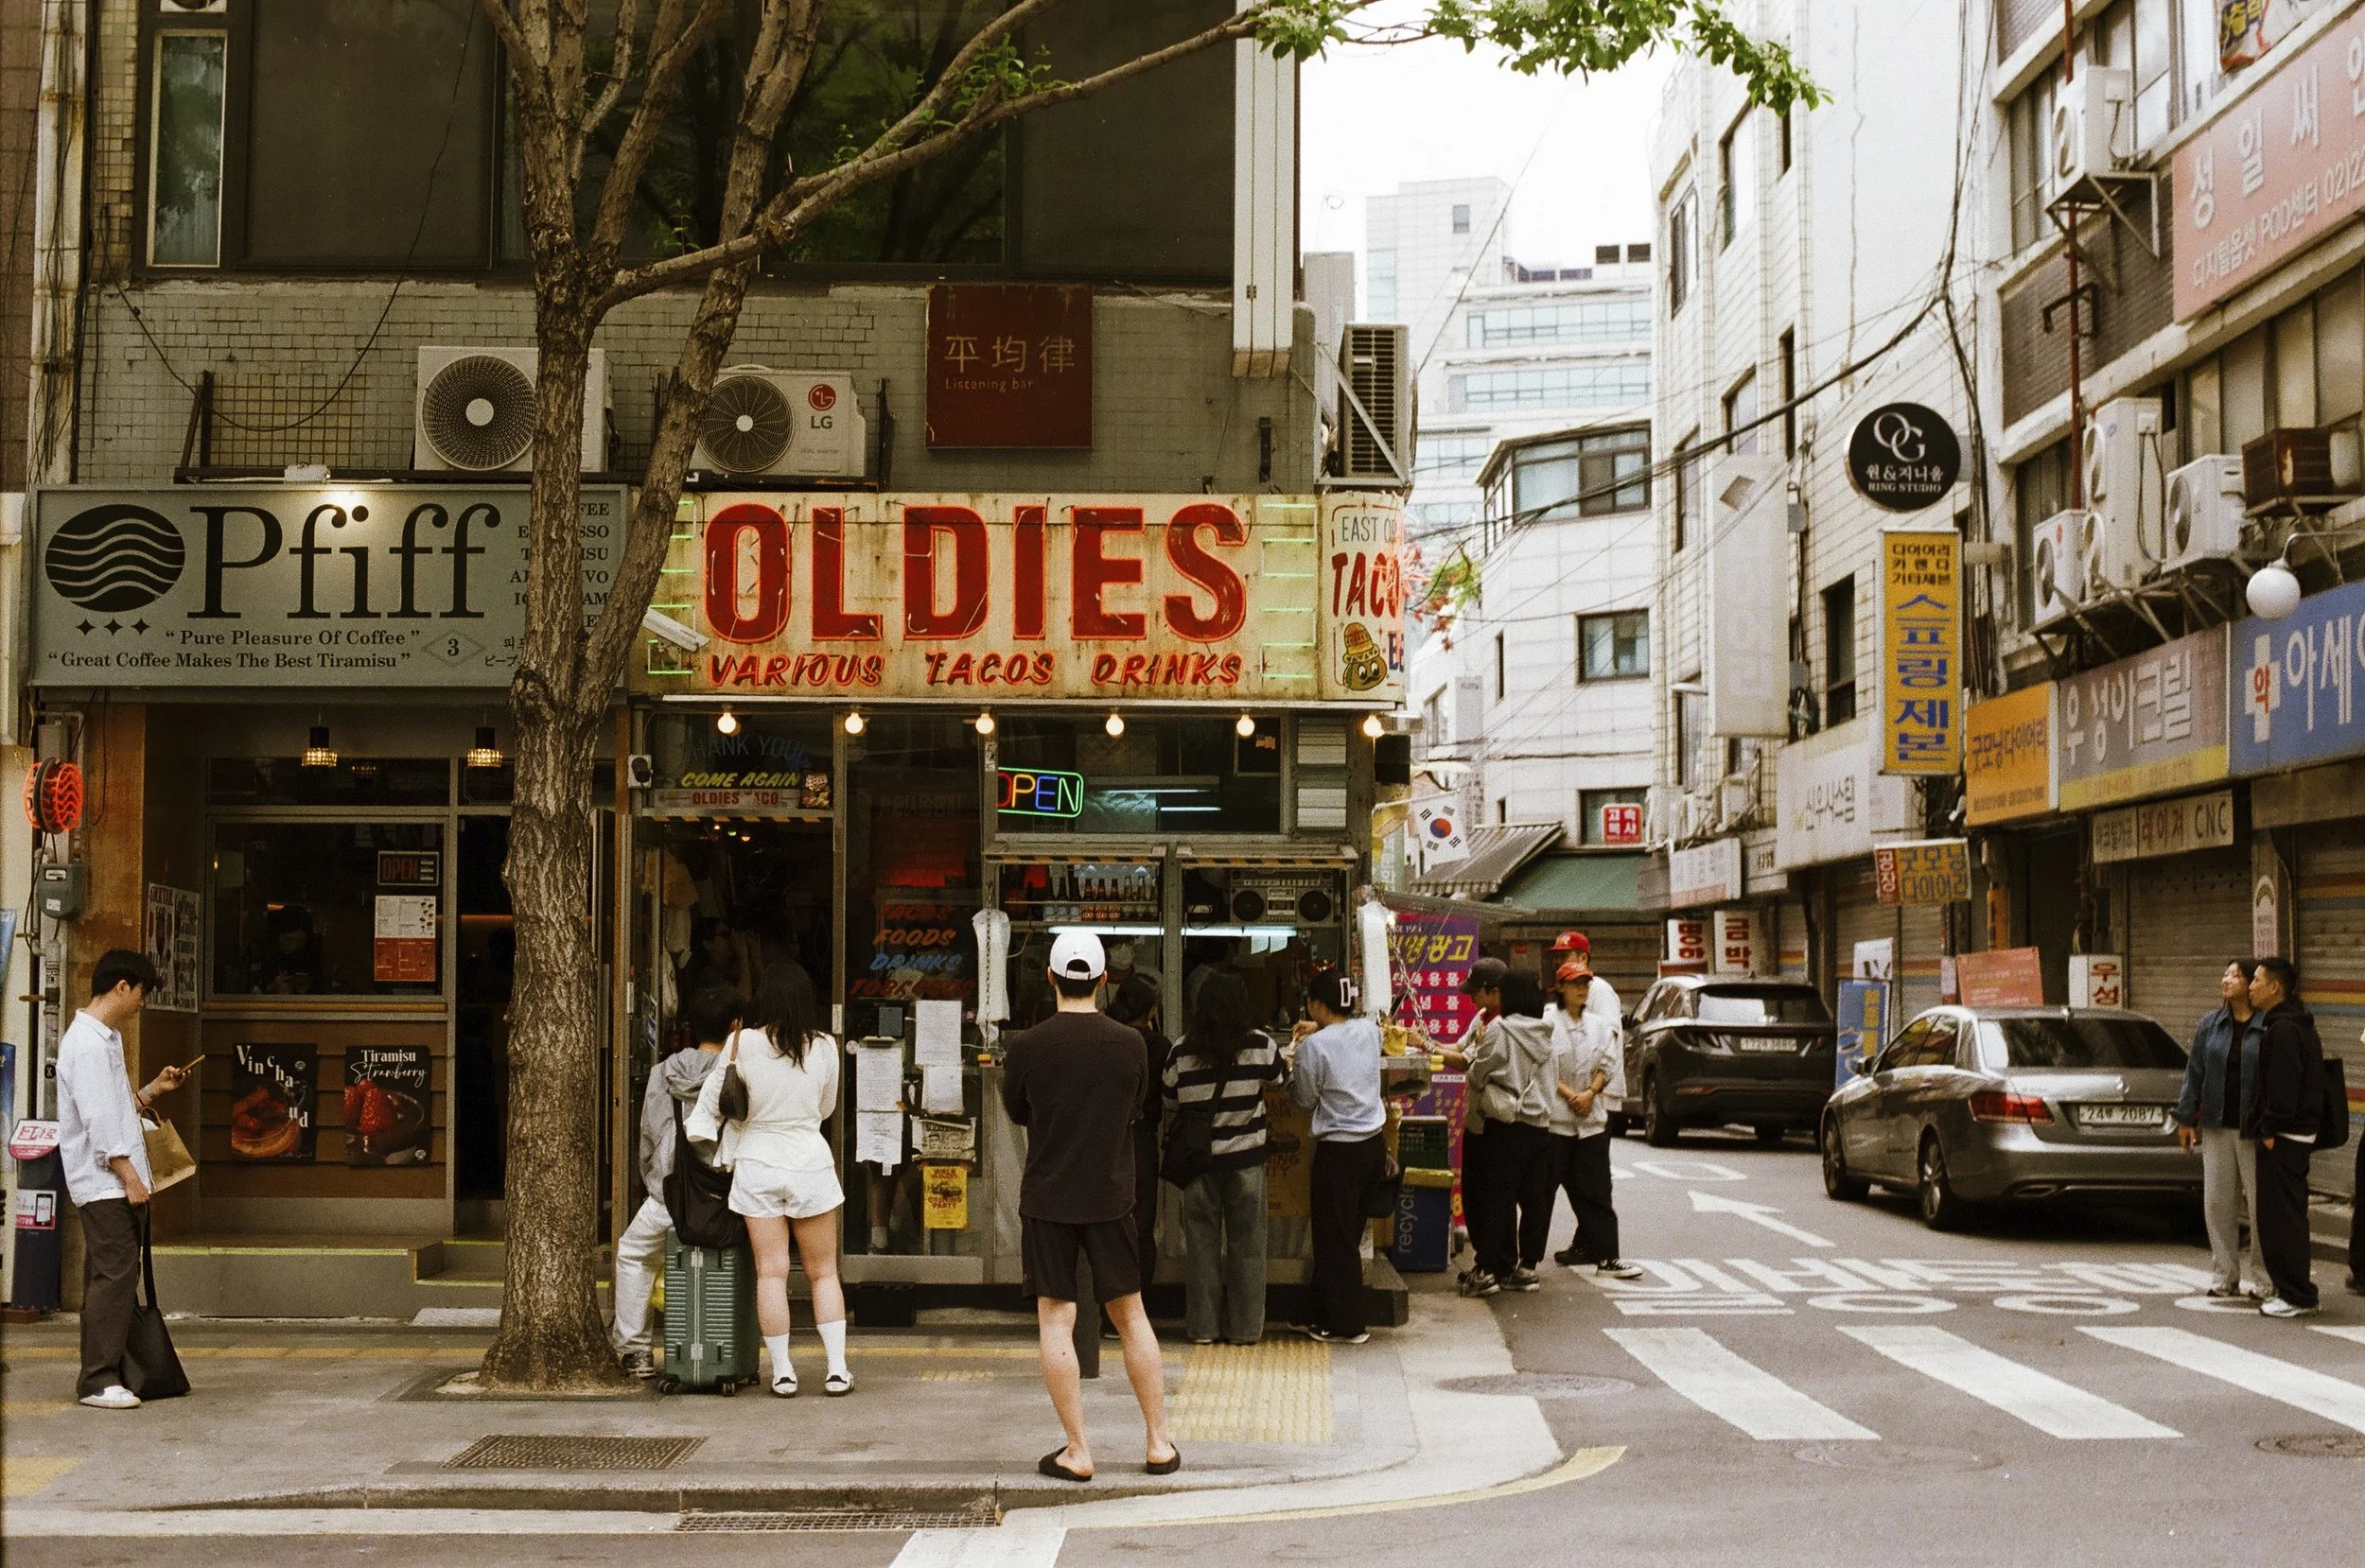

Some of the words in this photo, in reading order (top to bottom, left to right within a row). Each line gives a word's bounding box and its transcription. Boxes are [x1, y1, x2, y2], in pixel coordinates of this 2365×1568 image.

[944, 336, 1075, 373] 平均律
[946, 378, 1006, 392] Listening
[1012, 378, 1034, 390] bar
[811, 416, 832, 429] LG
[1868, 483, 1896, 492] RING
[1900, 483, 1941, 493] STUDIO
[1341, 516, 1378, 542] EAST
[187, 503, 500, 618] Pfiff
[705, 502, 1247, 643] OLDIES
[233, 630, 313, 646] Pleasure
[318, 630, 341, 646] Of
[447, 638, 460, 657] 3
[115, 653, 168, 669] Coffee
[169, 653, 231, 669] Makes
[236, 653, 269, 669] The
[274, 653, 312, 669] Best
[710, 652, 885, 687] VARIOUS
[925, 651, 1054, 686] TACOS
[1092, 652, 1243, 686] DRINKS
[2286, 611, 2365, 732] 아세
[2253, 665, 2269, 713] 약
[2066, 650, 2191, 767] 우성아크릴
[681, 772, 737, 787] COME
[740, 772, 800, 787] AGAIN
[692, 792, 739, 805] OLDIES
[2195, 801, 2227, 839] CNC
[382, 858, 418, 880] OPEN
[872, 929, 956, 947] FOODS
[869, 953, 962, 971] DRINKS
[2092, 963, 2120, 1005] 우성
[360, 1049, 415, 1062] Tiramisu
[350, 1060, 427, 1088] Strawberry
[1398, 1186, 1417, 1254] recycle
